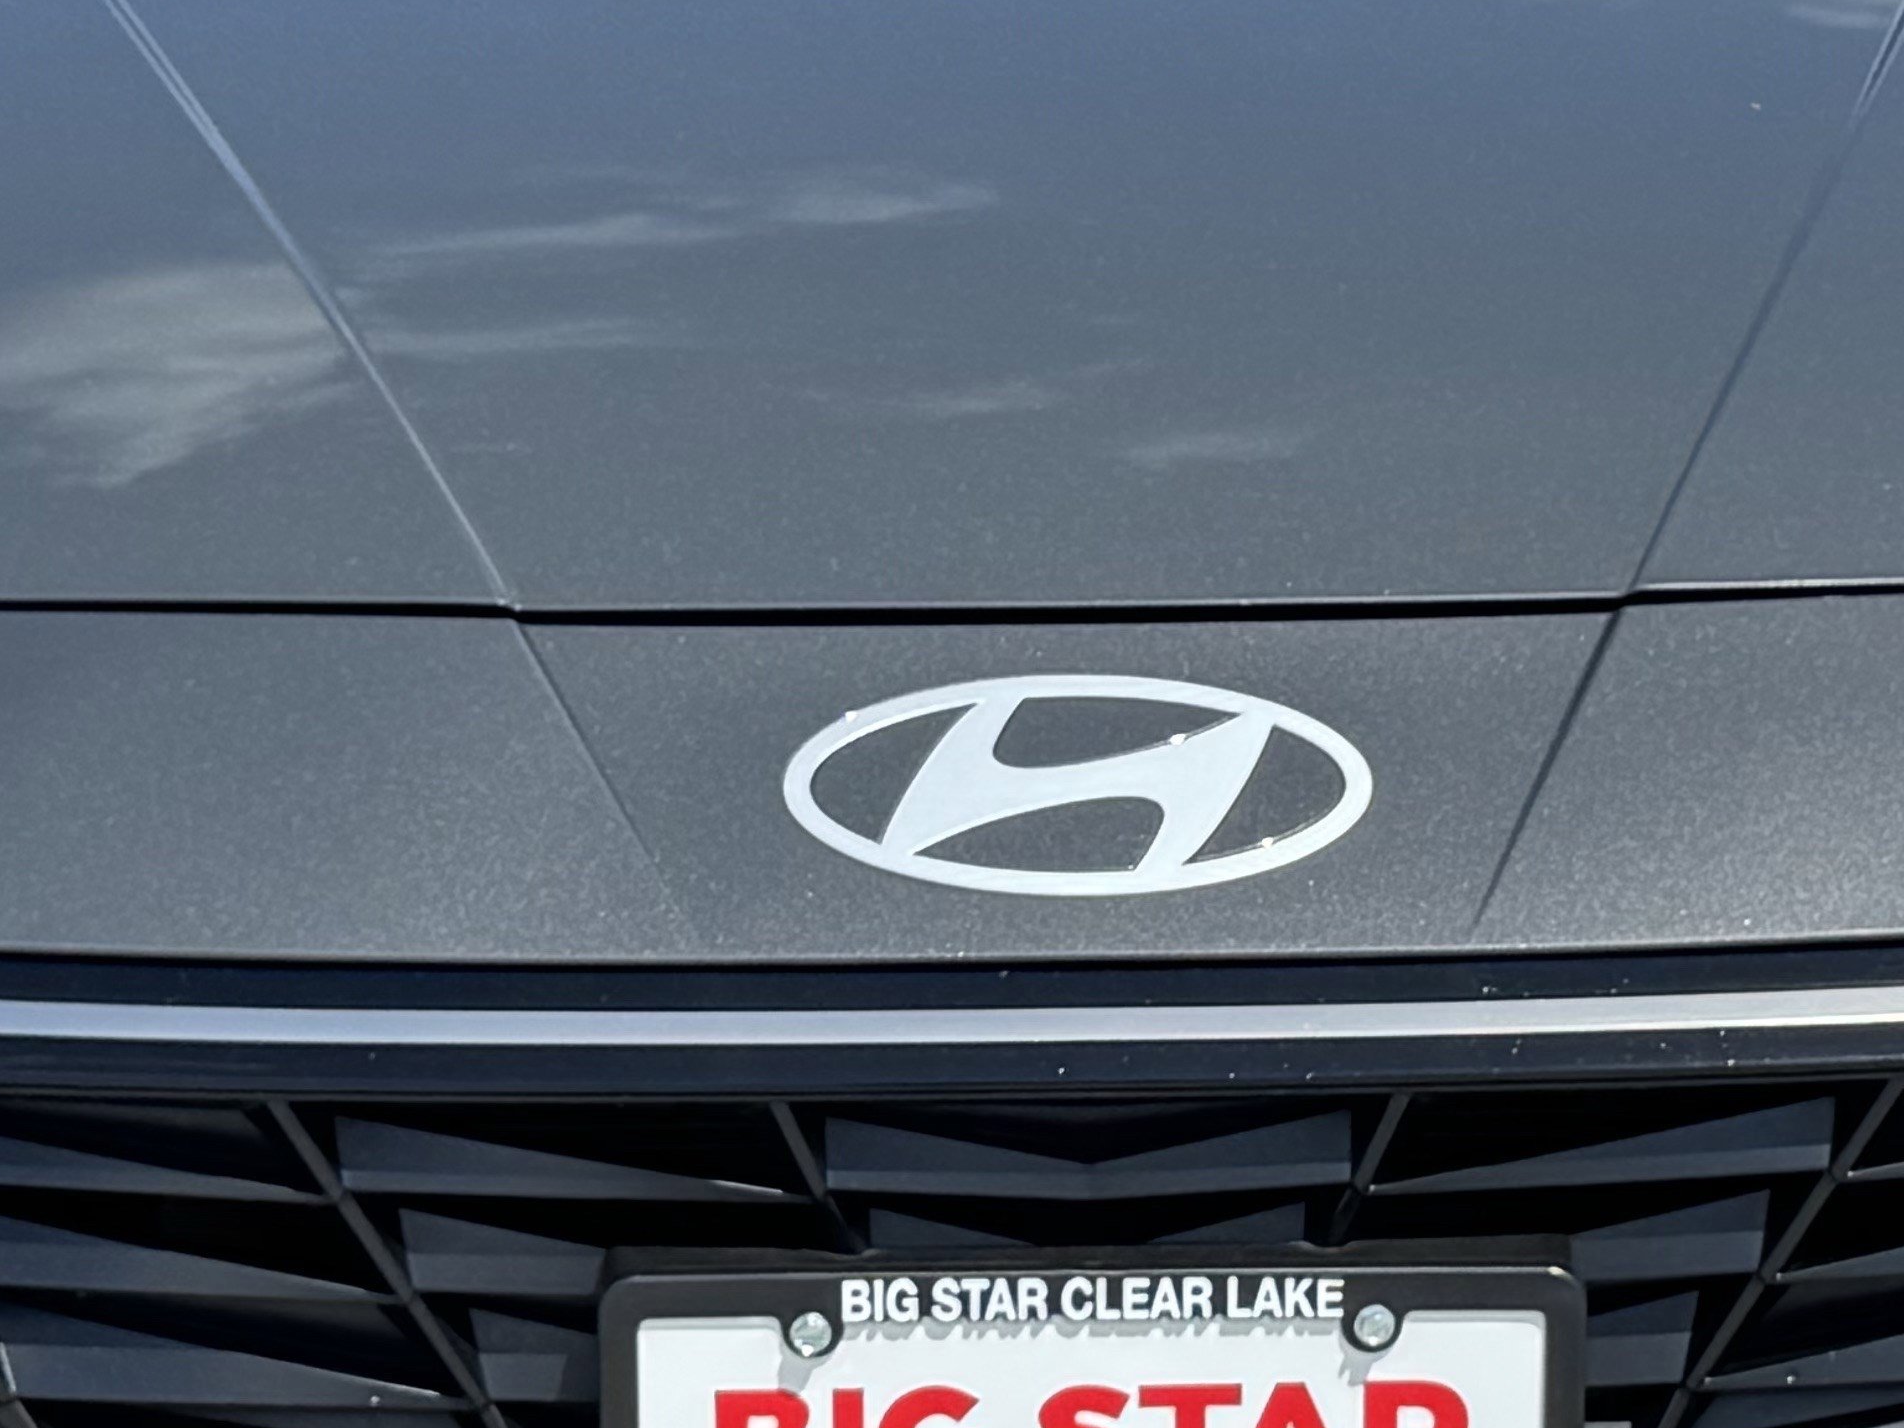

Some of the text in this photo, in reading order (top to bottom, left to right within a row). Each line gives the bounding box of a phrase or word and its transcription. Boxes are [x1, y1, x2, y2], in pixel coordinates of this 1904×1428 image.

[840, 1274, 1346, 1323] BIG STAR CLEAR LAKE
